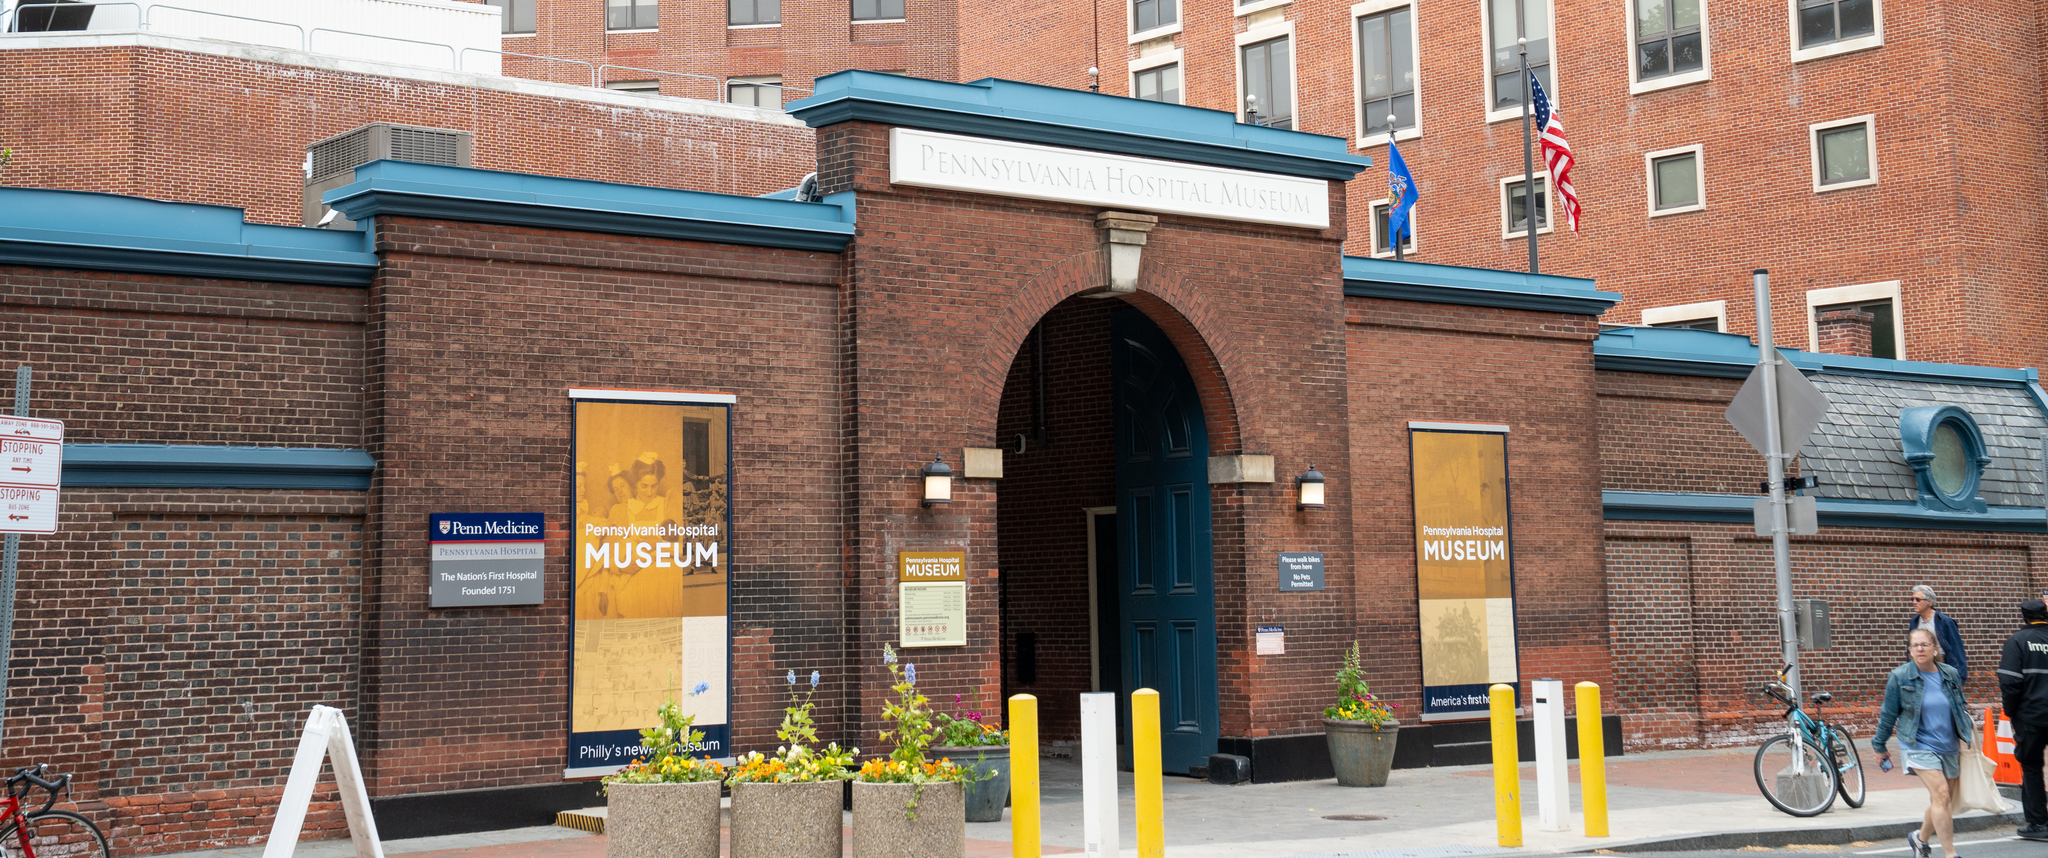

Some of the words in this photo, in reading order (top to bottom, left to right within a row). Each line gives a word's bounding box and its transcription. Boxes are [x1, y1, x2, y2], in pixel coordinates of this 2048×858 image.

[921, 144, 1097, 191] PENNSYLVANIA
[1106, 166, 1212, 204] HOSPITAL
[1220, 180, 1311, 215] MUSEUM
[3, 442, 43, 455] STOPPING
[0, 488, 40, 501] STOPPING
[452, 522, 482, 534] Penn
[484, 520, 538, 534] Medicine
[586, 524, 666, 539] Pennsylvania
[668, 524, 718, 538] Hospital
[1423, 525, 1472, 538] Pennsylvania
[1472, 526, 1504, 538] Hospital
[440, 548, 498, 556] PENNSYLVANIA
[500, 547, 538, 555] HOSPITAL
[585, 542, 718, 568] MUSEUM
[1424, 540, 1504, 560] MUSEUM
[440, 572, 455, 581] The
[457, 572, 487, 581] Nation's
[488, 572, 504, 580] First
[506, 571, 537, 581] Hospital
[906, 564, 959, 576] MUSEUM
[462, 586, 496, 595] Founded
[498, 586, 516, 594] 1751
[1431, 695, 1467, 707] America's
[1468, 694, 1482, 704] first
[580, 744, 621, 760] Philly's
